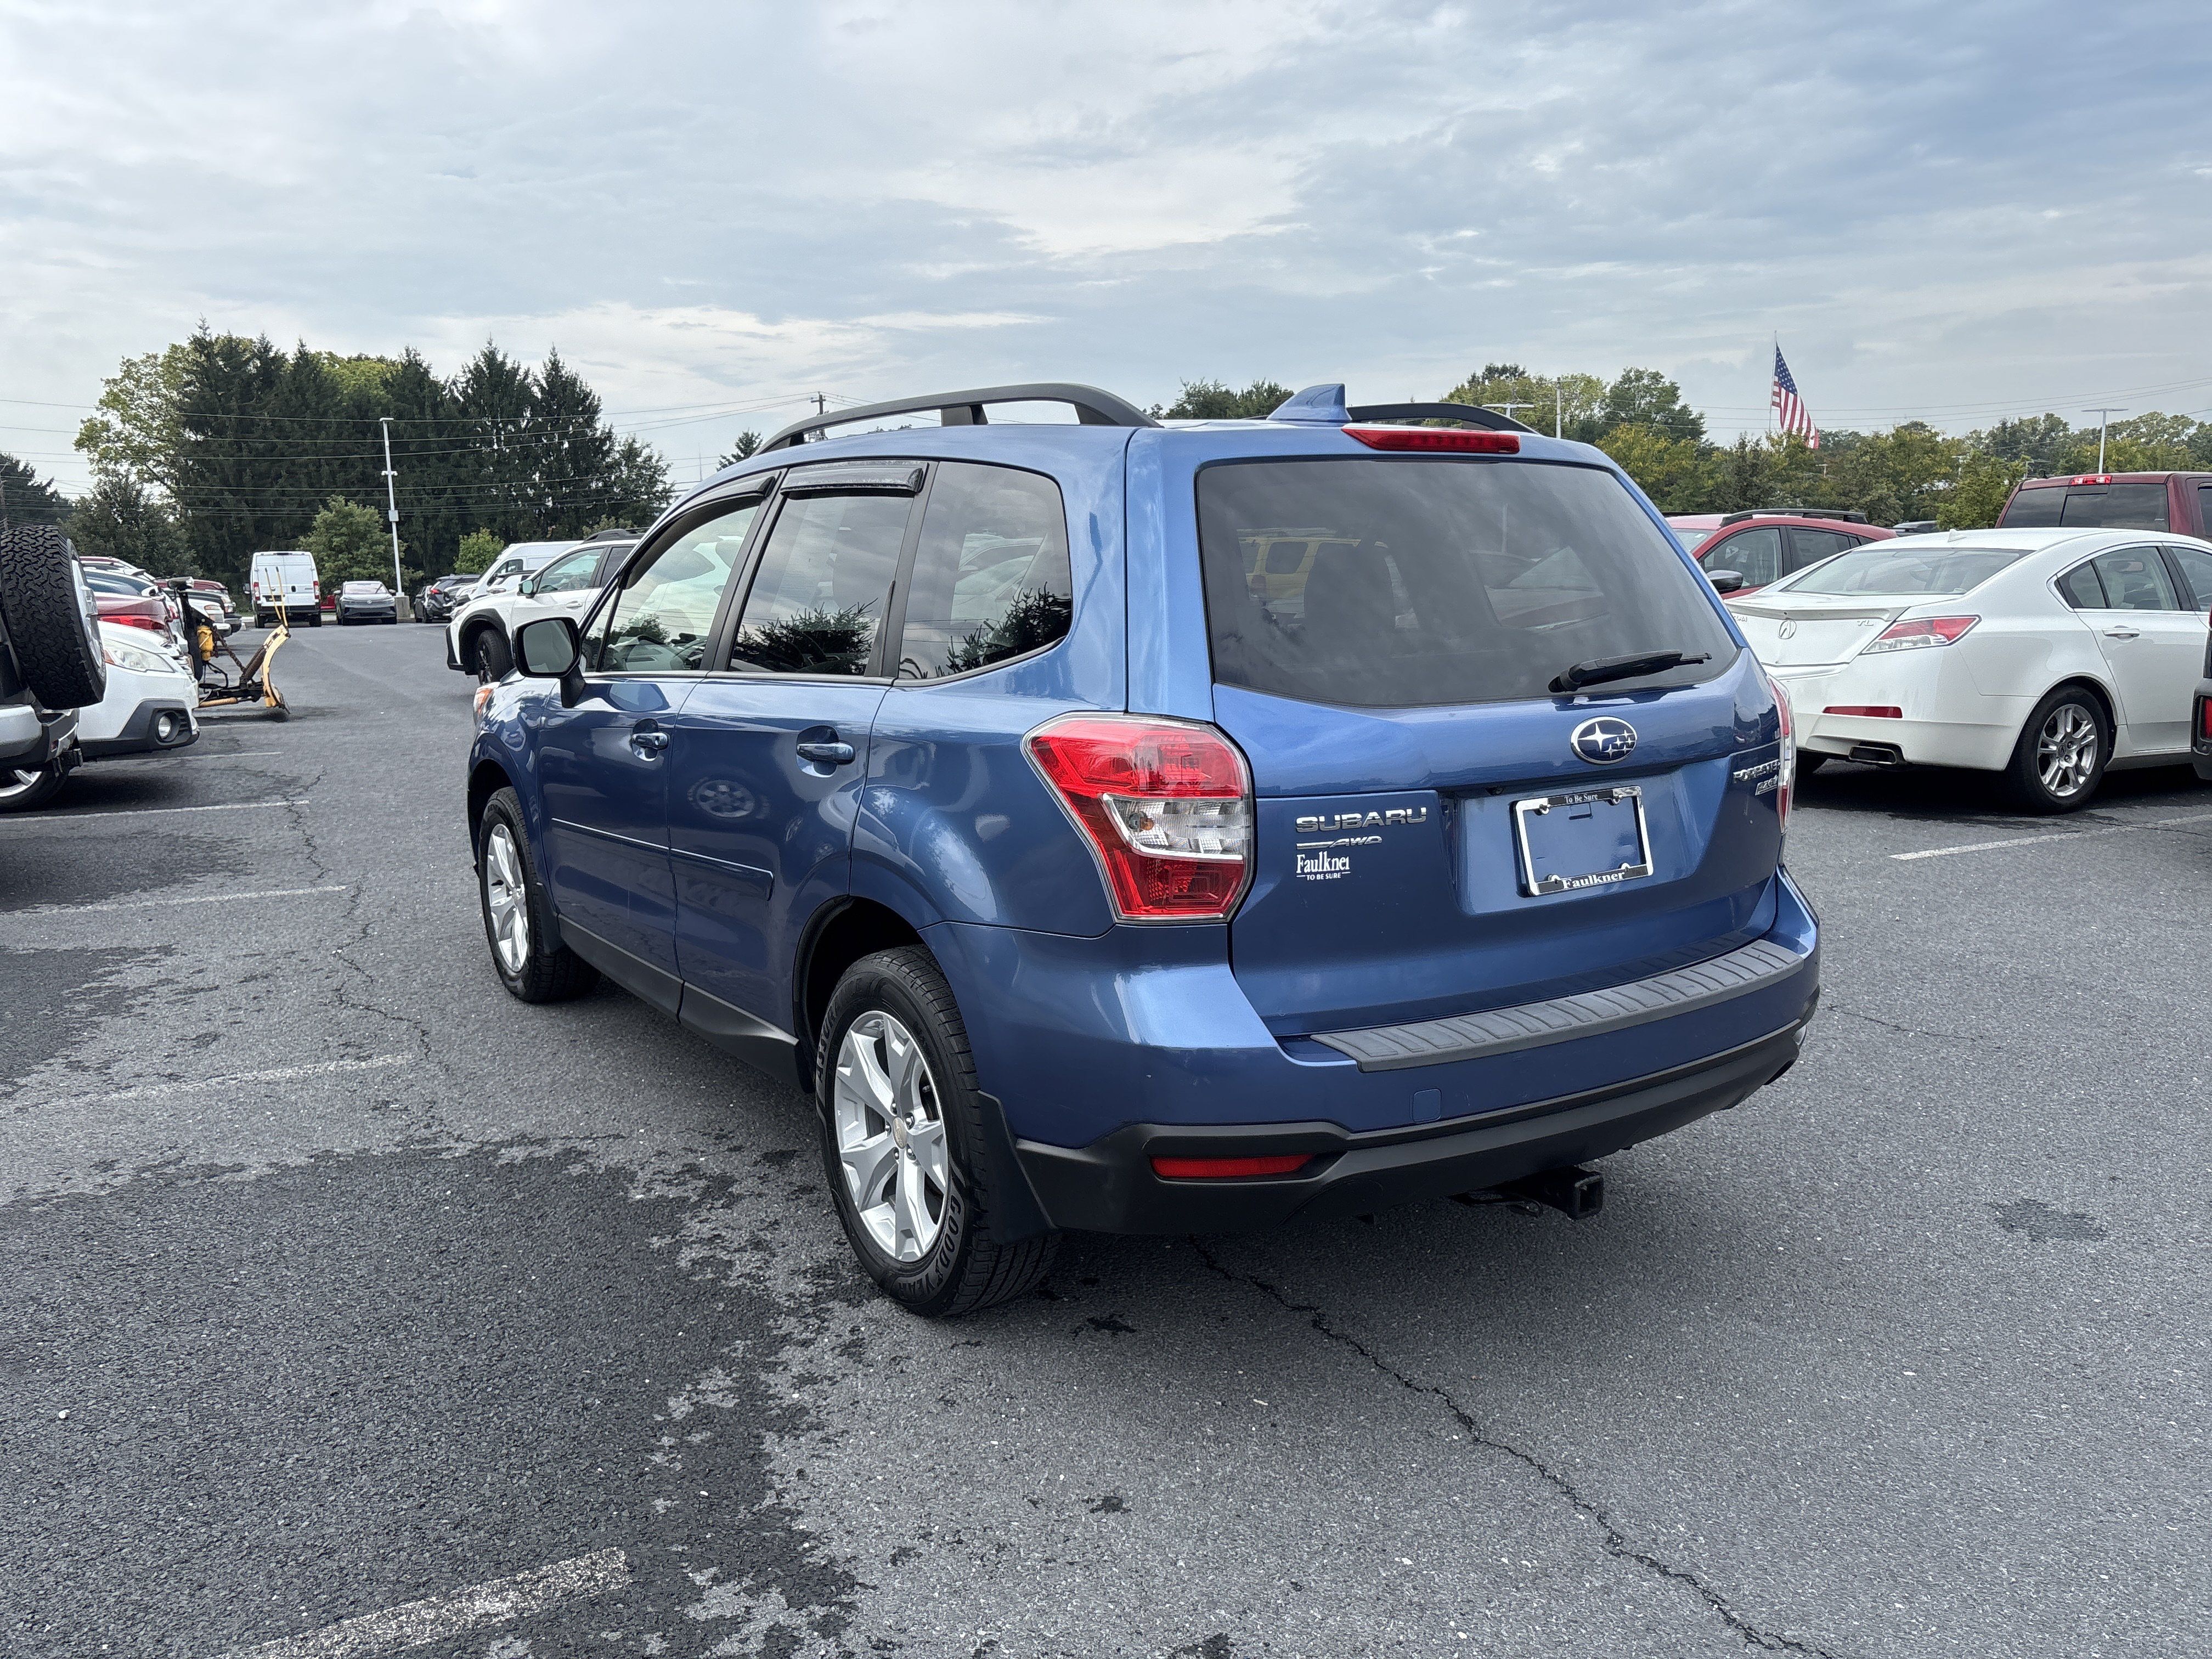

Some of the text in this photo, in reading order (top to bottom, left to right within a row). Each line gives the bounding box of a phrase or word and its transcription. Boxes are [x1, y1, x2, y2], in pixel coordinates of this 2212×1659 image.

[1295, 807, 1427, 833] SUBARU
[1329, 836, 1383, 848] AWD
[1562, 872, 1626, 889] Faulkner
